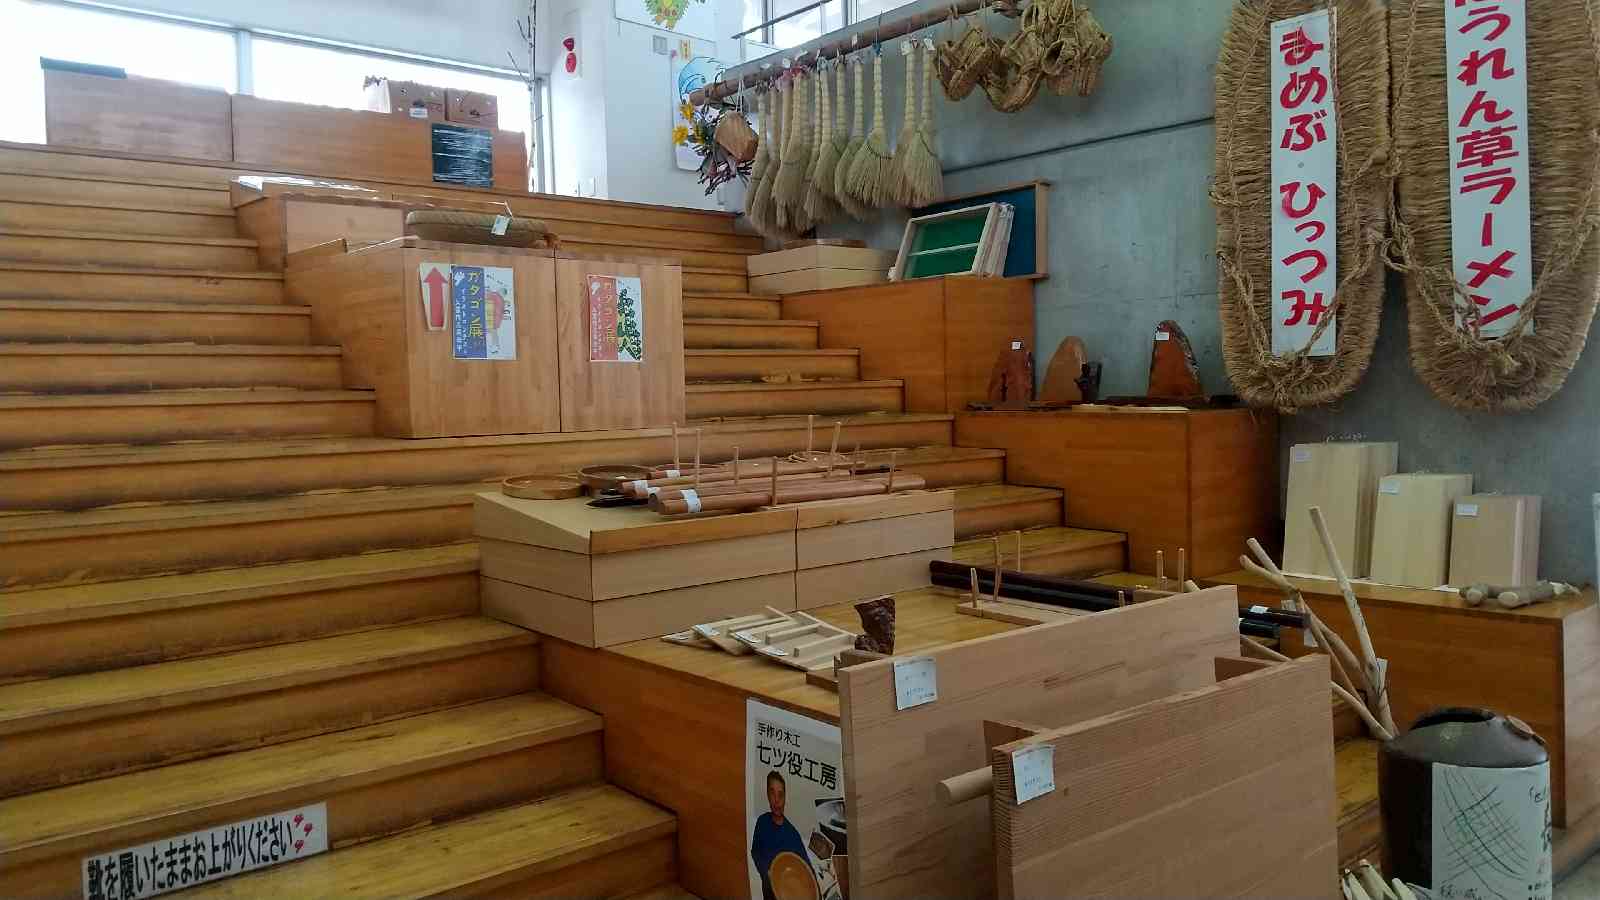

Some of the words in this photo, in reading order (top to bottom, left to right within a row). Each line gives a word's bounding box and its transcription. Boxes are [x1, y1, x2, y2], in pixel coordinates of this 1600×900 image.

[1454, 0, 1519, 327] うれん草ラーメン
[756, 740, 838, 791] 七ツ役工房
[757, 722, 801, 749] 手作り木工
[87, 816, 294, 900] 靴を履いたままお上がりください
